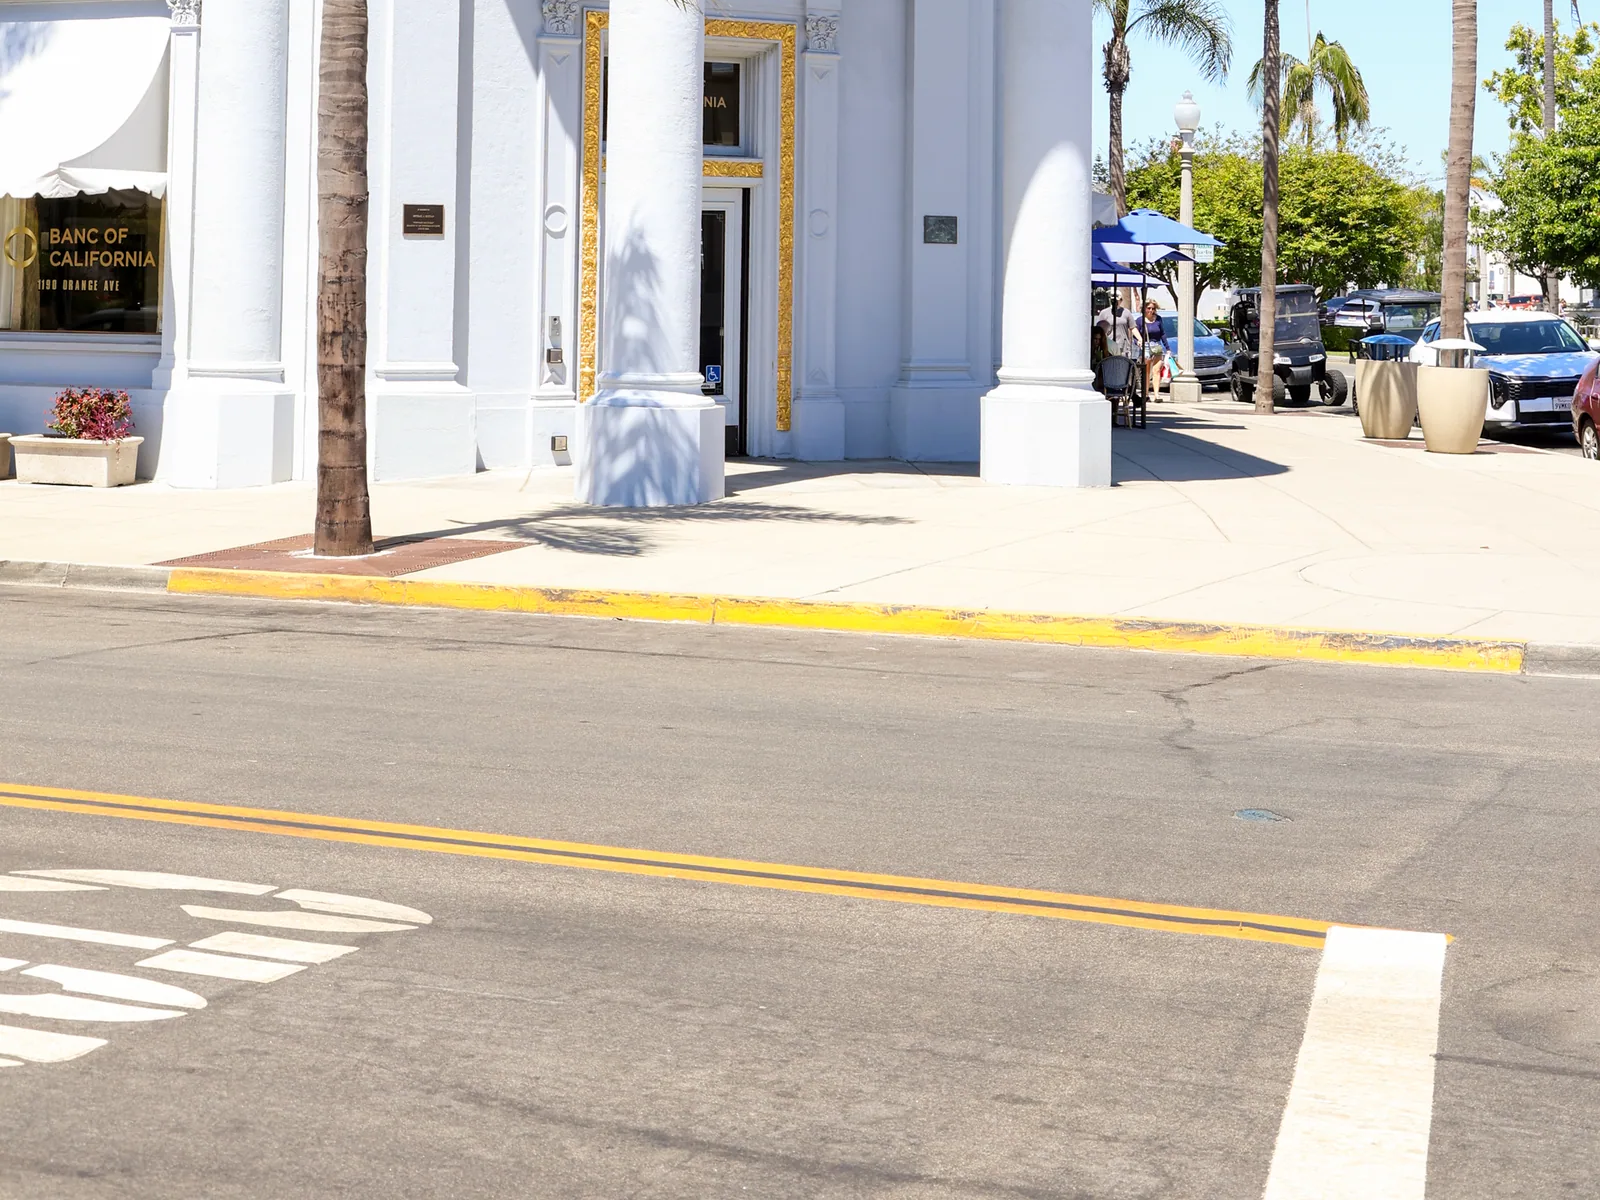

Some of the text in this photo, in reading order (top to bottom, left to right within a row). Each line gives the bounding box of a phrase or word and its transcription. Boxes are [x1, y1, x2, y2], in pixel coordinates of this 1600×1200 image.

[49, 228, 128, 244] BANC OF
[49, 251, 156, 267] CALIFORNIA
[37, 279, 120, 292] 1190 ORANGE AVE
